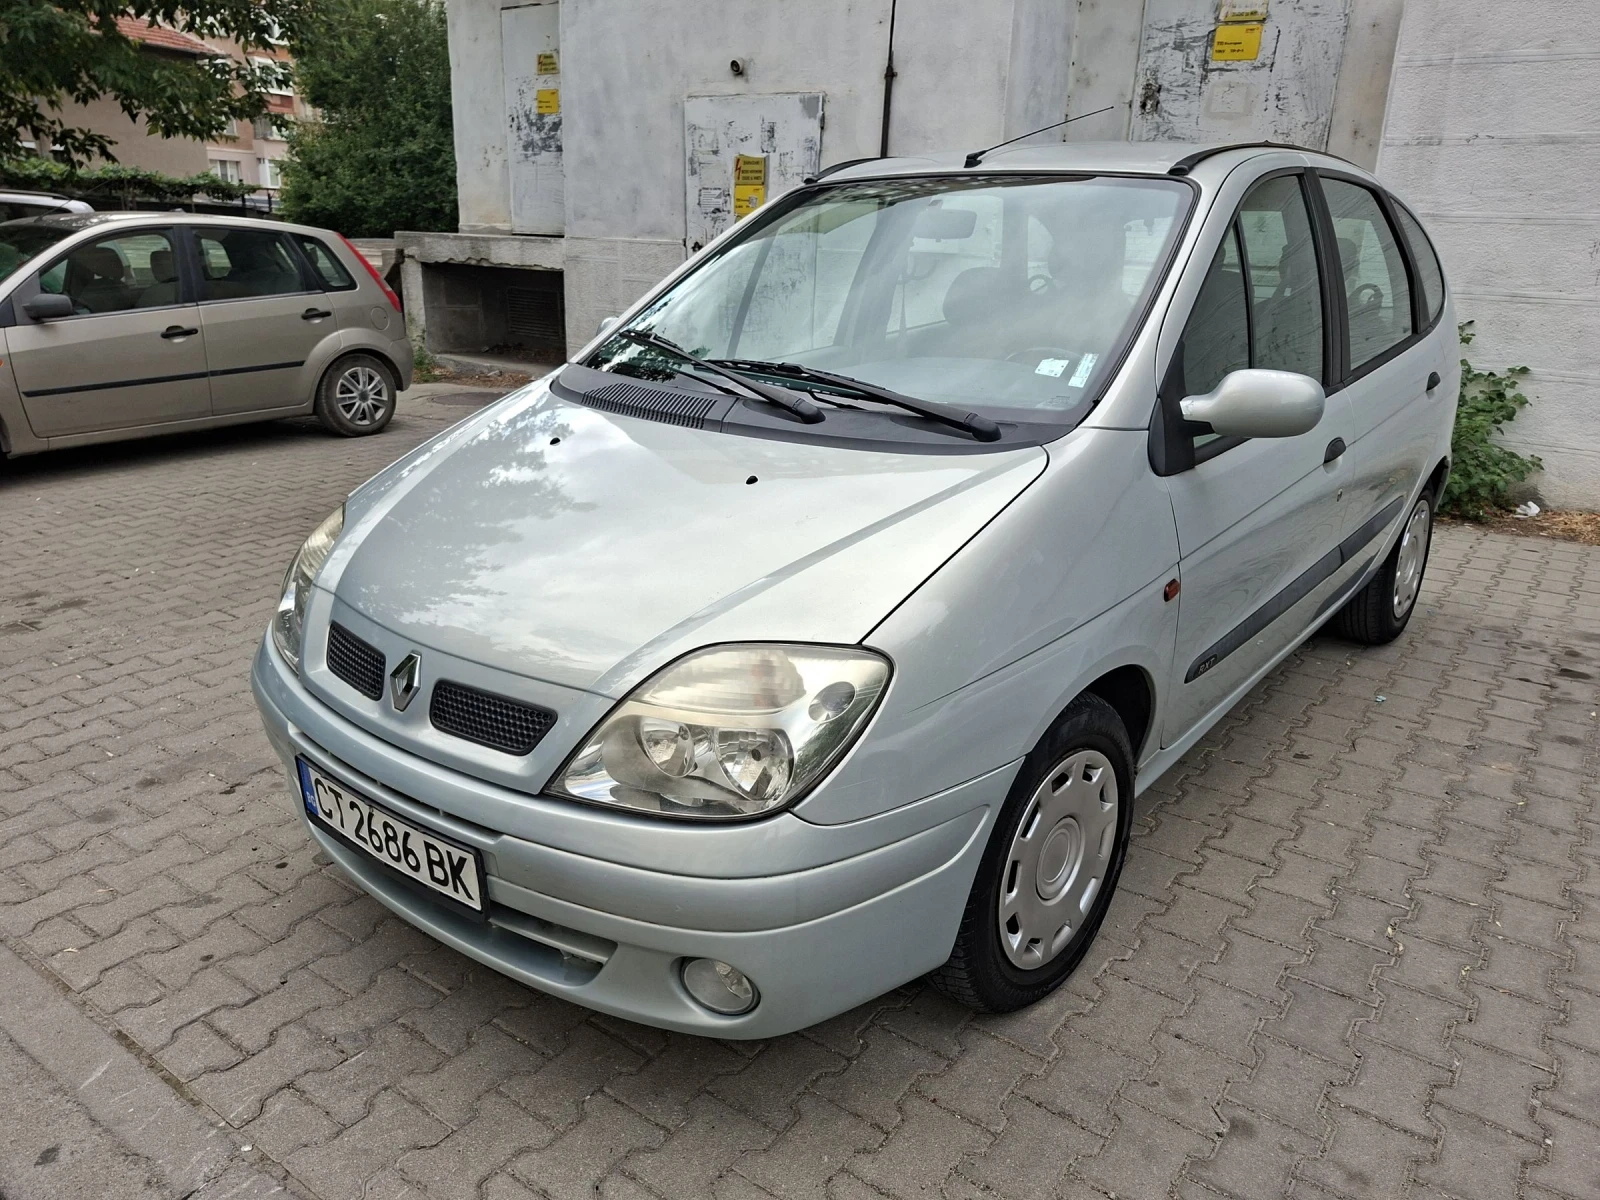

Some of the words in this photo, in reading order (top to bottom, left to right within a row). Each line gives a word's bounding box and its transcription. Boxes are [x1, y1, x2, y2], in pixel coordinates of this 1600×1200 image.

[314, 777, 345, 829] CT
[349, 800, 421, 873] 2686
[423, 839, 475, 901] BK
